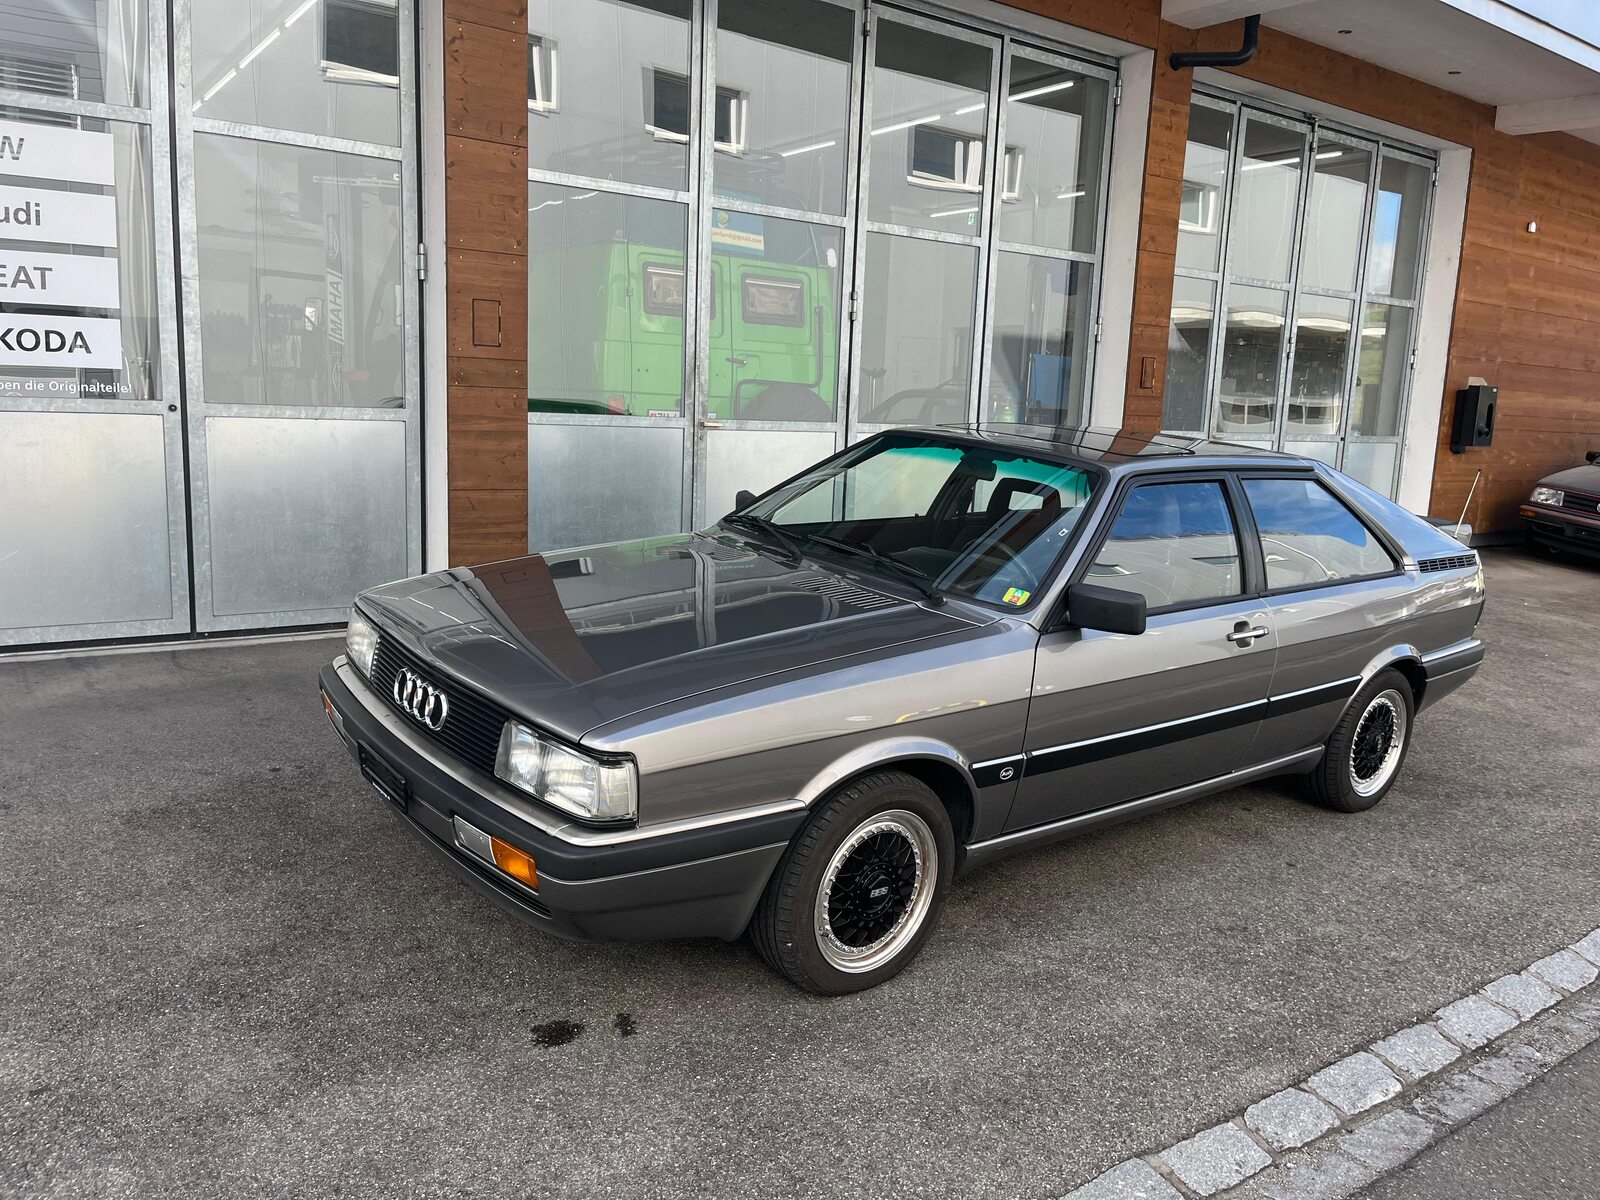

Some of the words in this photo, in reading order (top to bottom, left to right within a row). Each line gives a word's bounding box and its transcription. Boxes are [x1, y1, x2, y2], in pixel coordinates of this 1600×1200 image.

[328, 279, 343, 335] MAHA
[0, 328, 92, 354] KODA
[24, 380, 45, 391] die
[48, 381, 132, 394] Originalteile!
